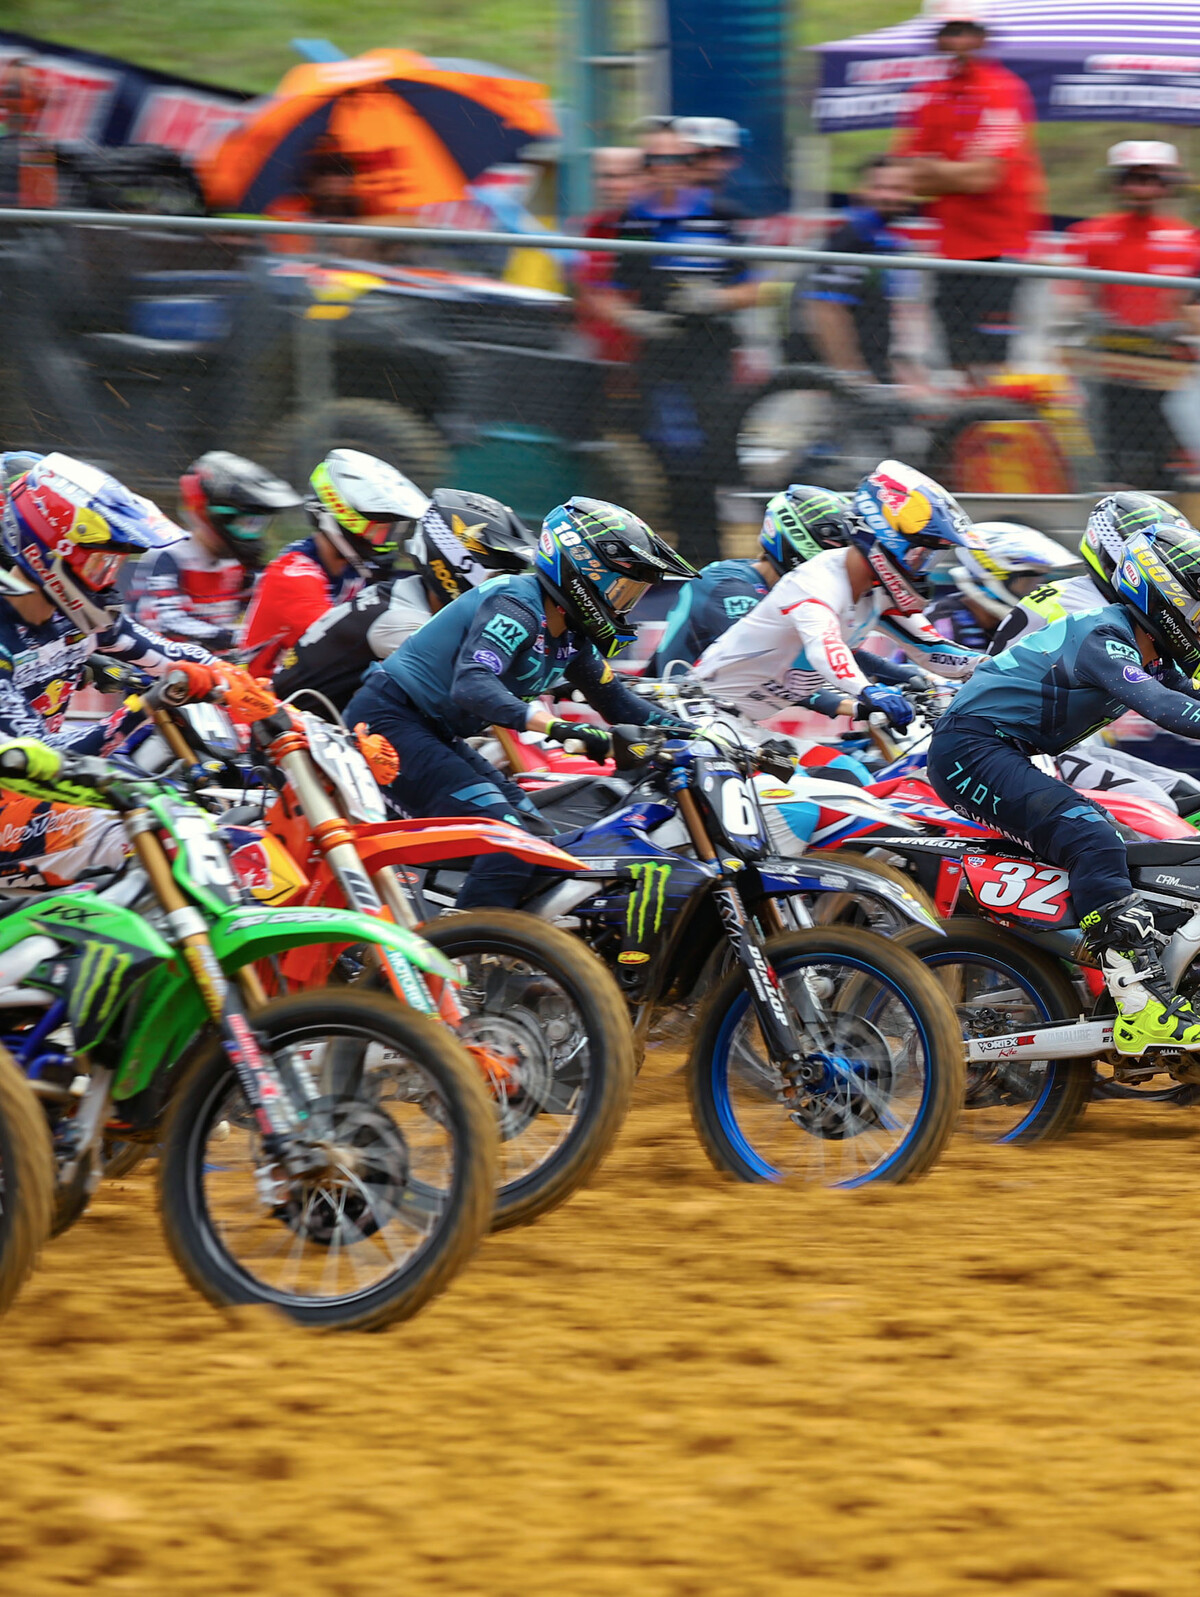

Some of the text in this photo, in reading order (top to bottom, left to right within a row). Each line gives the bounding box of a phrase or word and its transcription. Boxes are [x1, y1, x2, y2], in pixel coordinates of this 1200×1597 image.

[552, 520, 608, 581] 100%
[1125, 564, 1138, 584] BELL
[1132, 544, 1192, 607] 100%
[493, 618, 523, 644] MX
[1160, 609, 1192, 650] MONSTER
[928, 652, 970, 667] HONDA
[721, 777, 760, 836] 6
[885, 837, 967, 849] DUNLOP
[979, 861, 1069, 916] 32
[748, 944, 789, 1027] DUNLOP
[977, 1036, 1018, 1052] VORTEX
